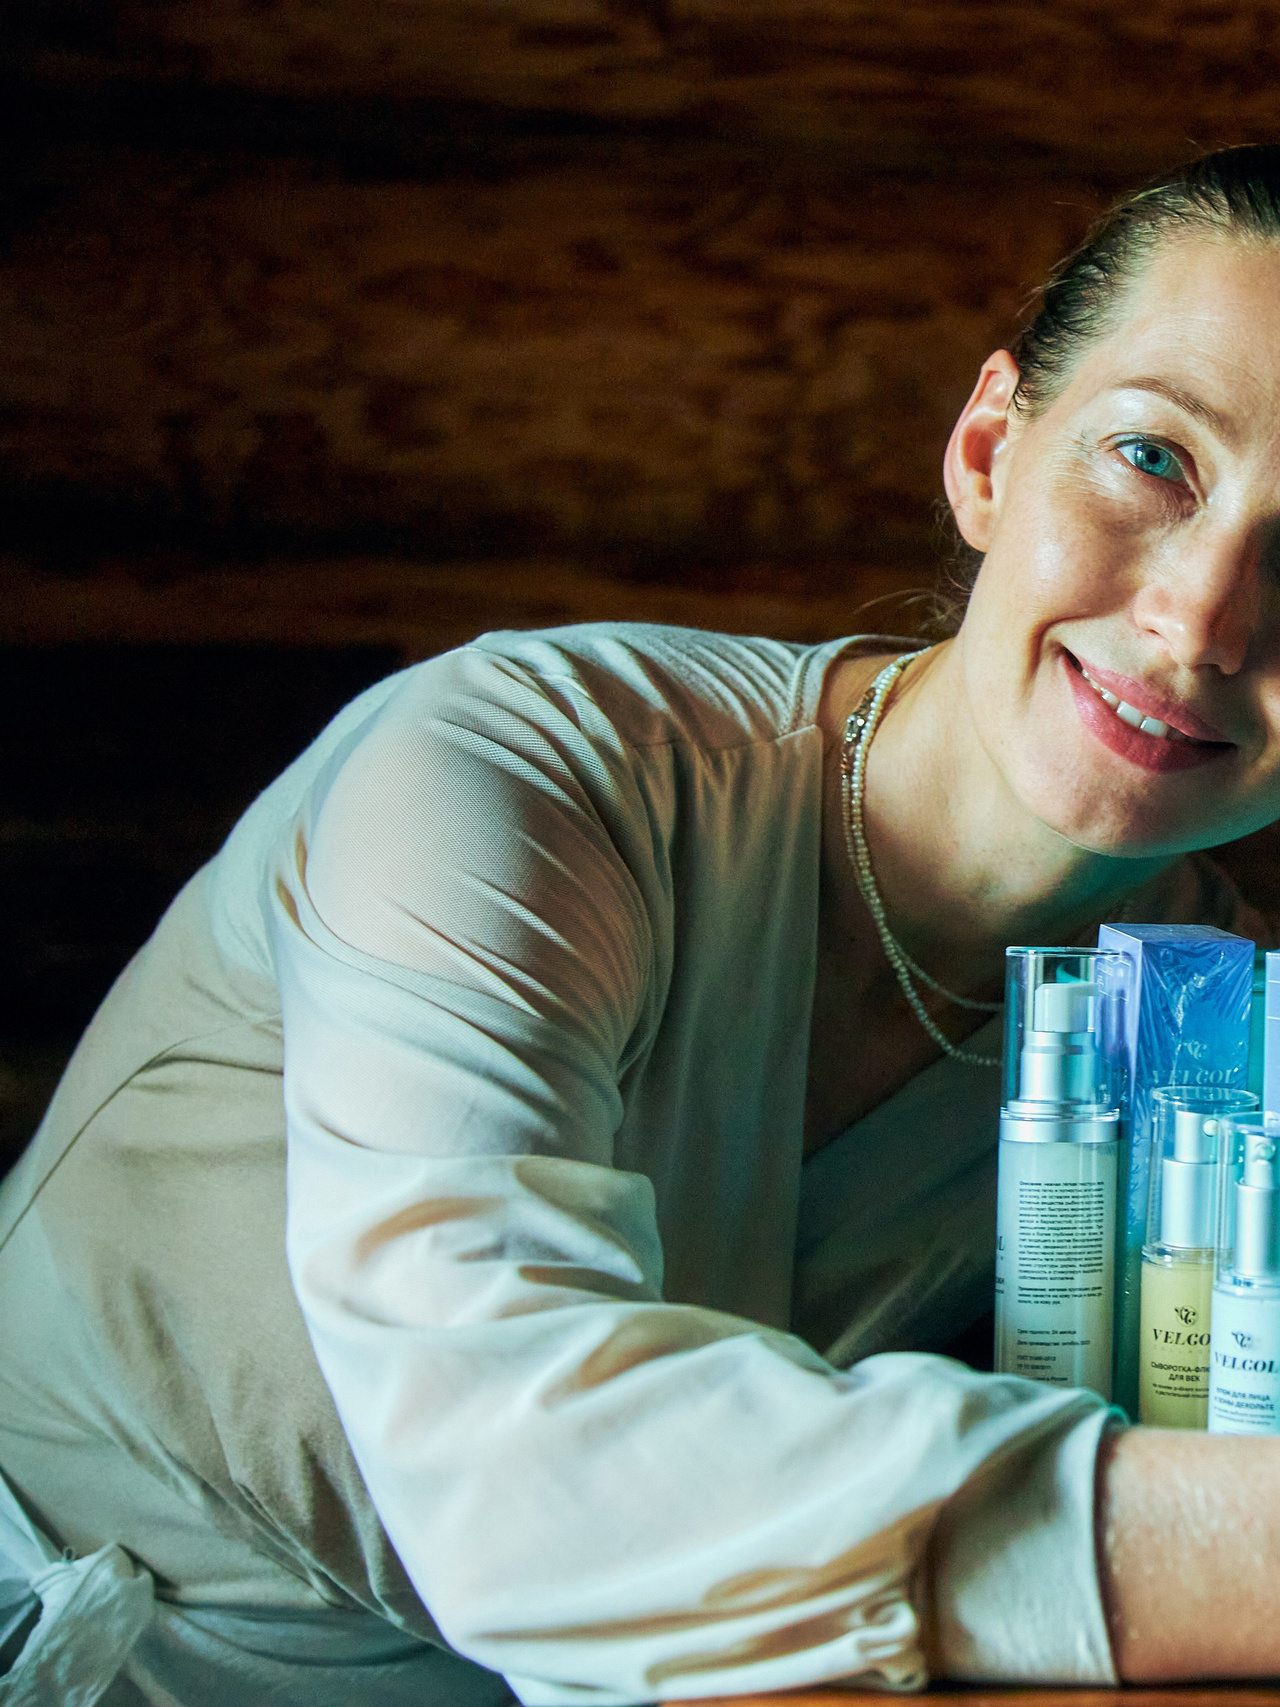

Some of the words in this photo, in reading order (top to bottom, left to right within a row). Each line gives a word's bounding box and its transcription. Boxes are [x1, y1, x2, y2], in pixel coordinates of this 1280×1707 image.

[1152, 1069, 1237, 1086] VELGOL
[1153, 1328, 1211, 1346] VELGO
[1215, 1351, 1280, 1374] VELGOL
[1168, 1373, 1184, 1381] ДЛЯ
[1185, 1374, 1201, 1382] ВЕК
[1248, 1394, 1270, 1402] ЛИЦА
[1235, 1401, 1276, 1411] ДЕКОЛЬТЕ
